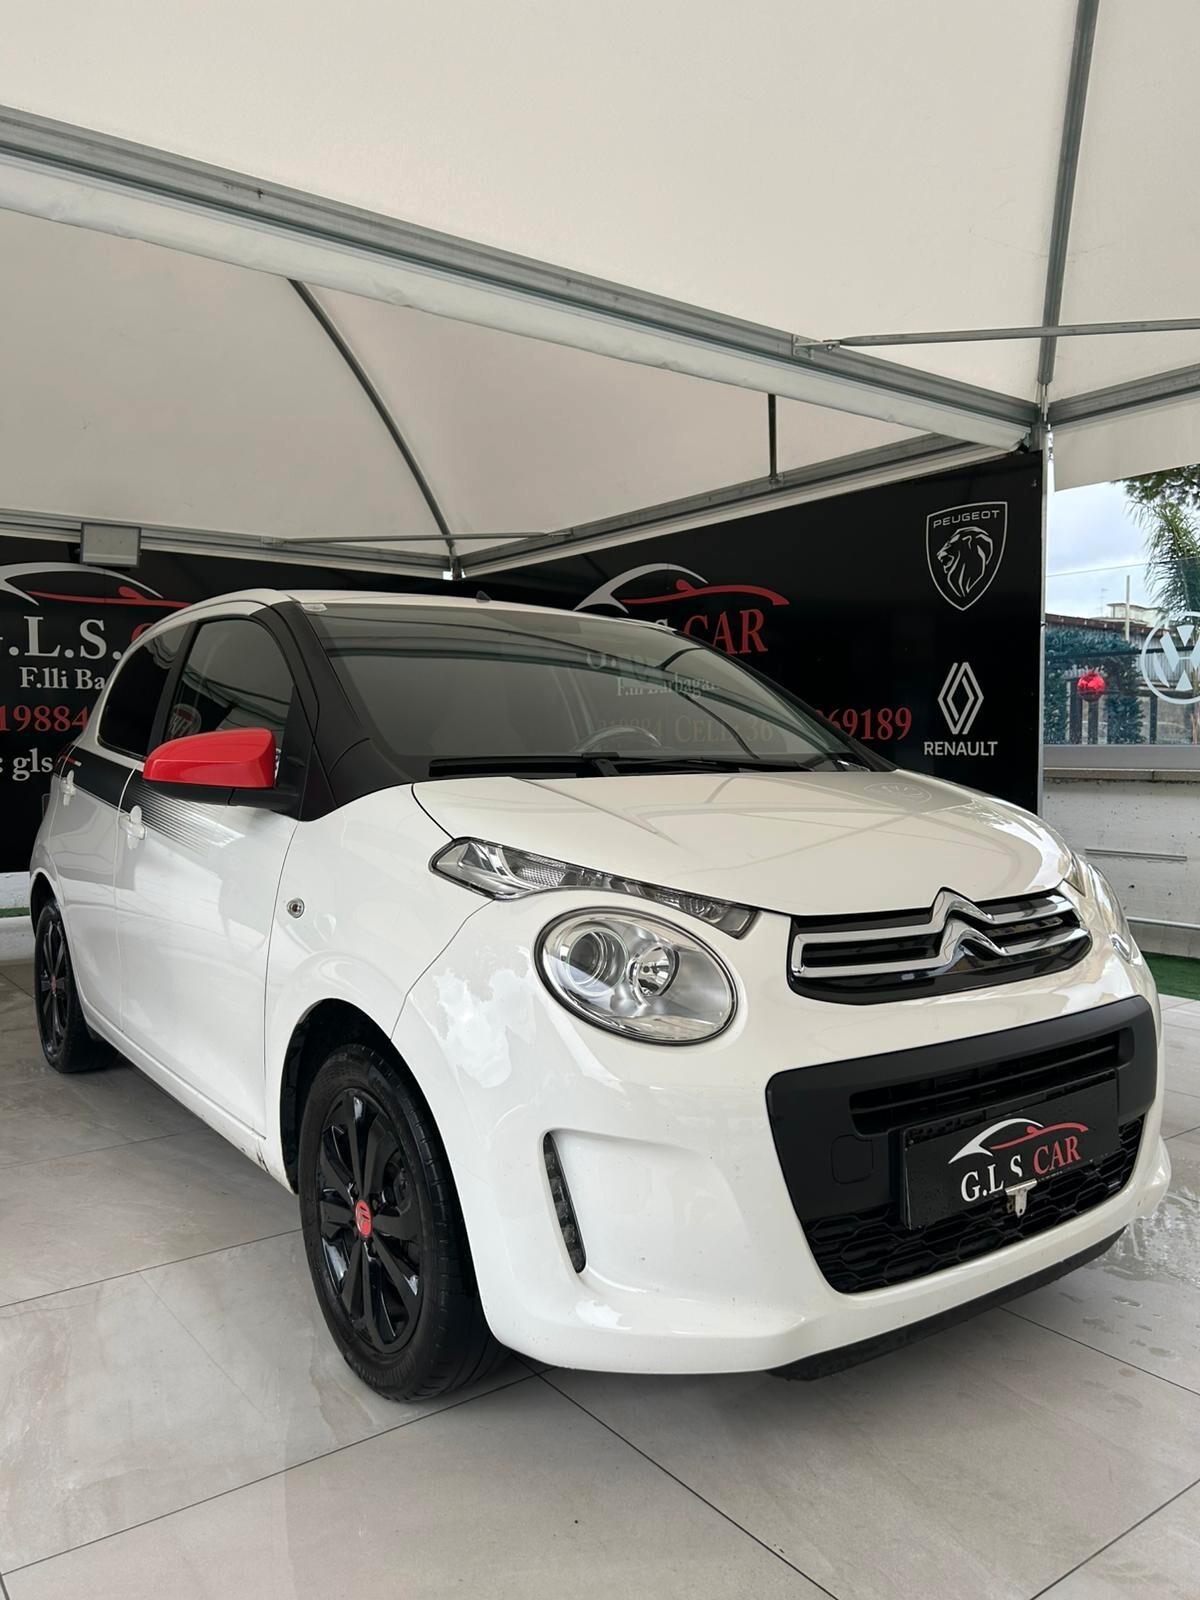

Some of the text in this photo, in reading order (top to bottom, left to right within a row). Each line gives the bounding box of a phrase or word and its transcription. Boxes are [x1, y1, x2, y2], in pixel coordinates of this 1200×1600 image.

[933, 510, 999, 528] PEUGEOT
[0, 615, 122, 659] .L.S.
[19, 666, 69, 689] F.lli
[923, 741, 998, 756] RENAULT
[1033, 1135, 1081, 1175] CAR
